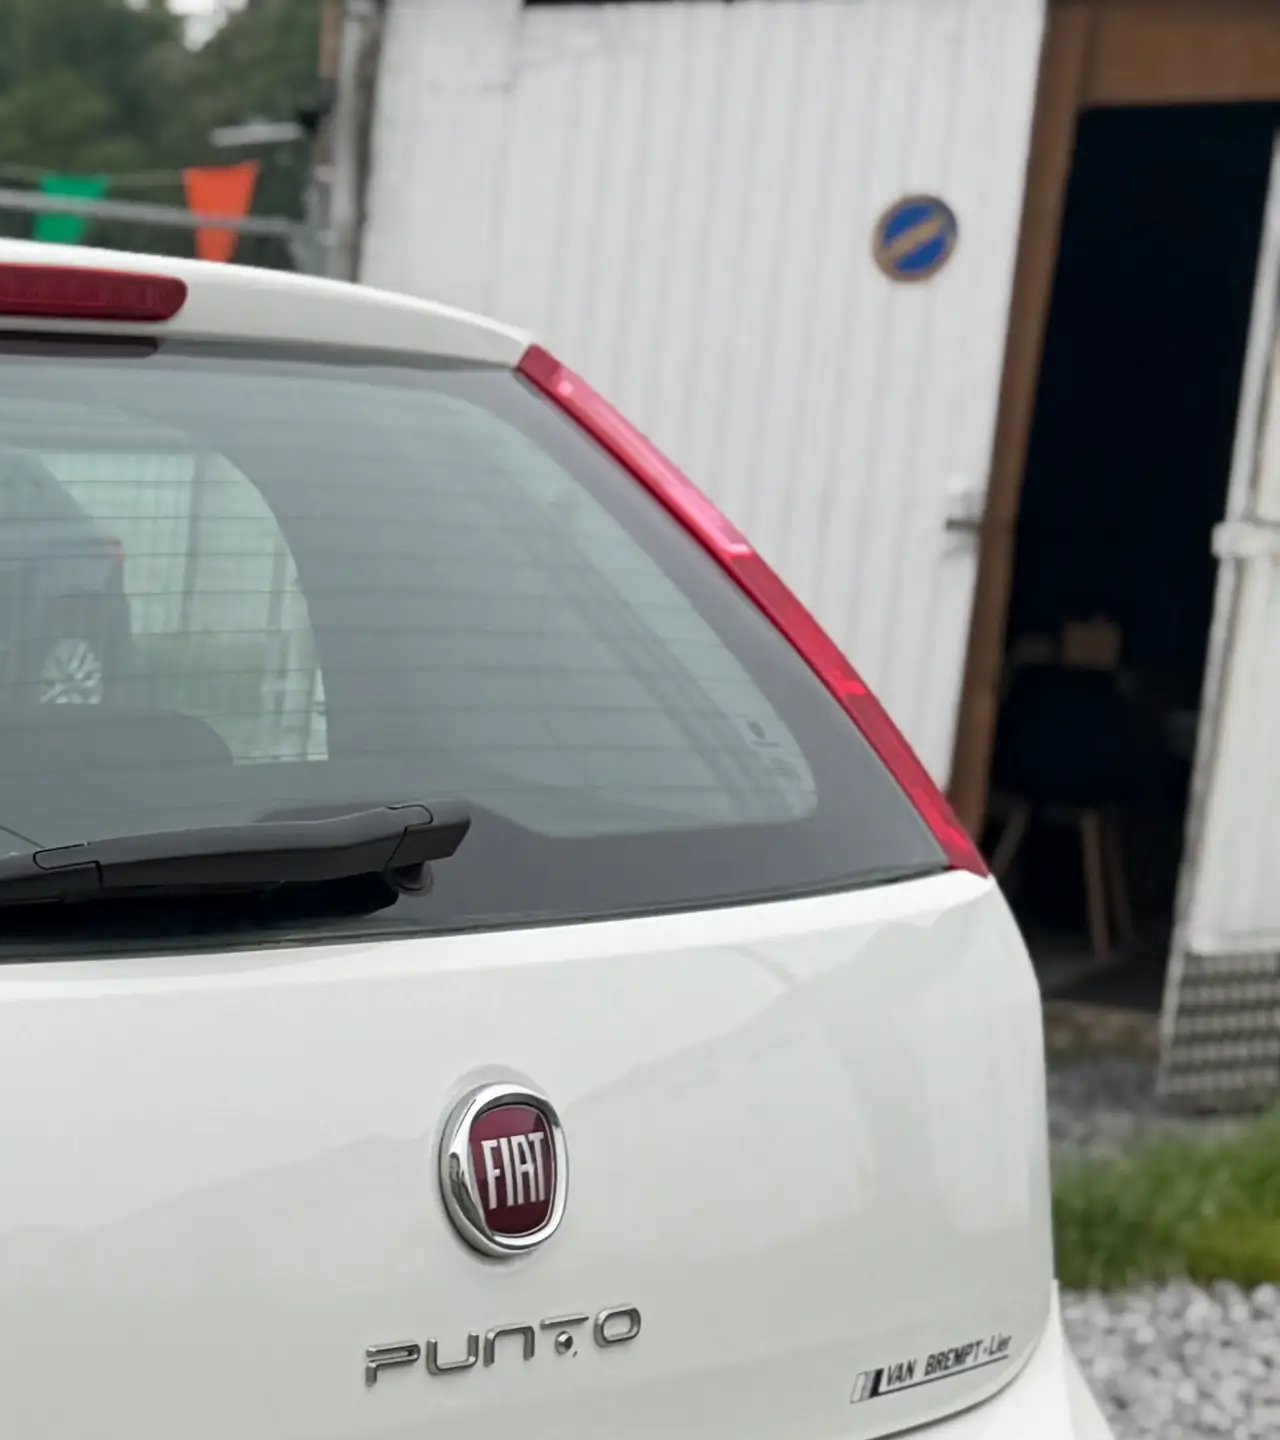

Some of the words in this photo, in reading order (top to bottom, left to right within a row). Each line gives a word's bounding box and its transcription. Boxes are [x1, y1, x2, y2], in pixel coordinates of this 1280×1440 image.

[481, 1131, 545, 1211] FIAT
[366, 1304, 642, 1387] PUNTO
[887, 1359, 917, 1387] VAN
